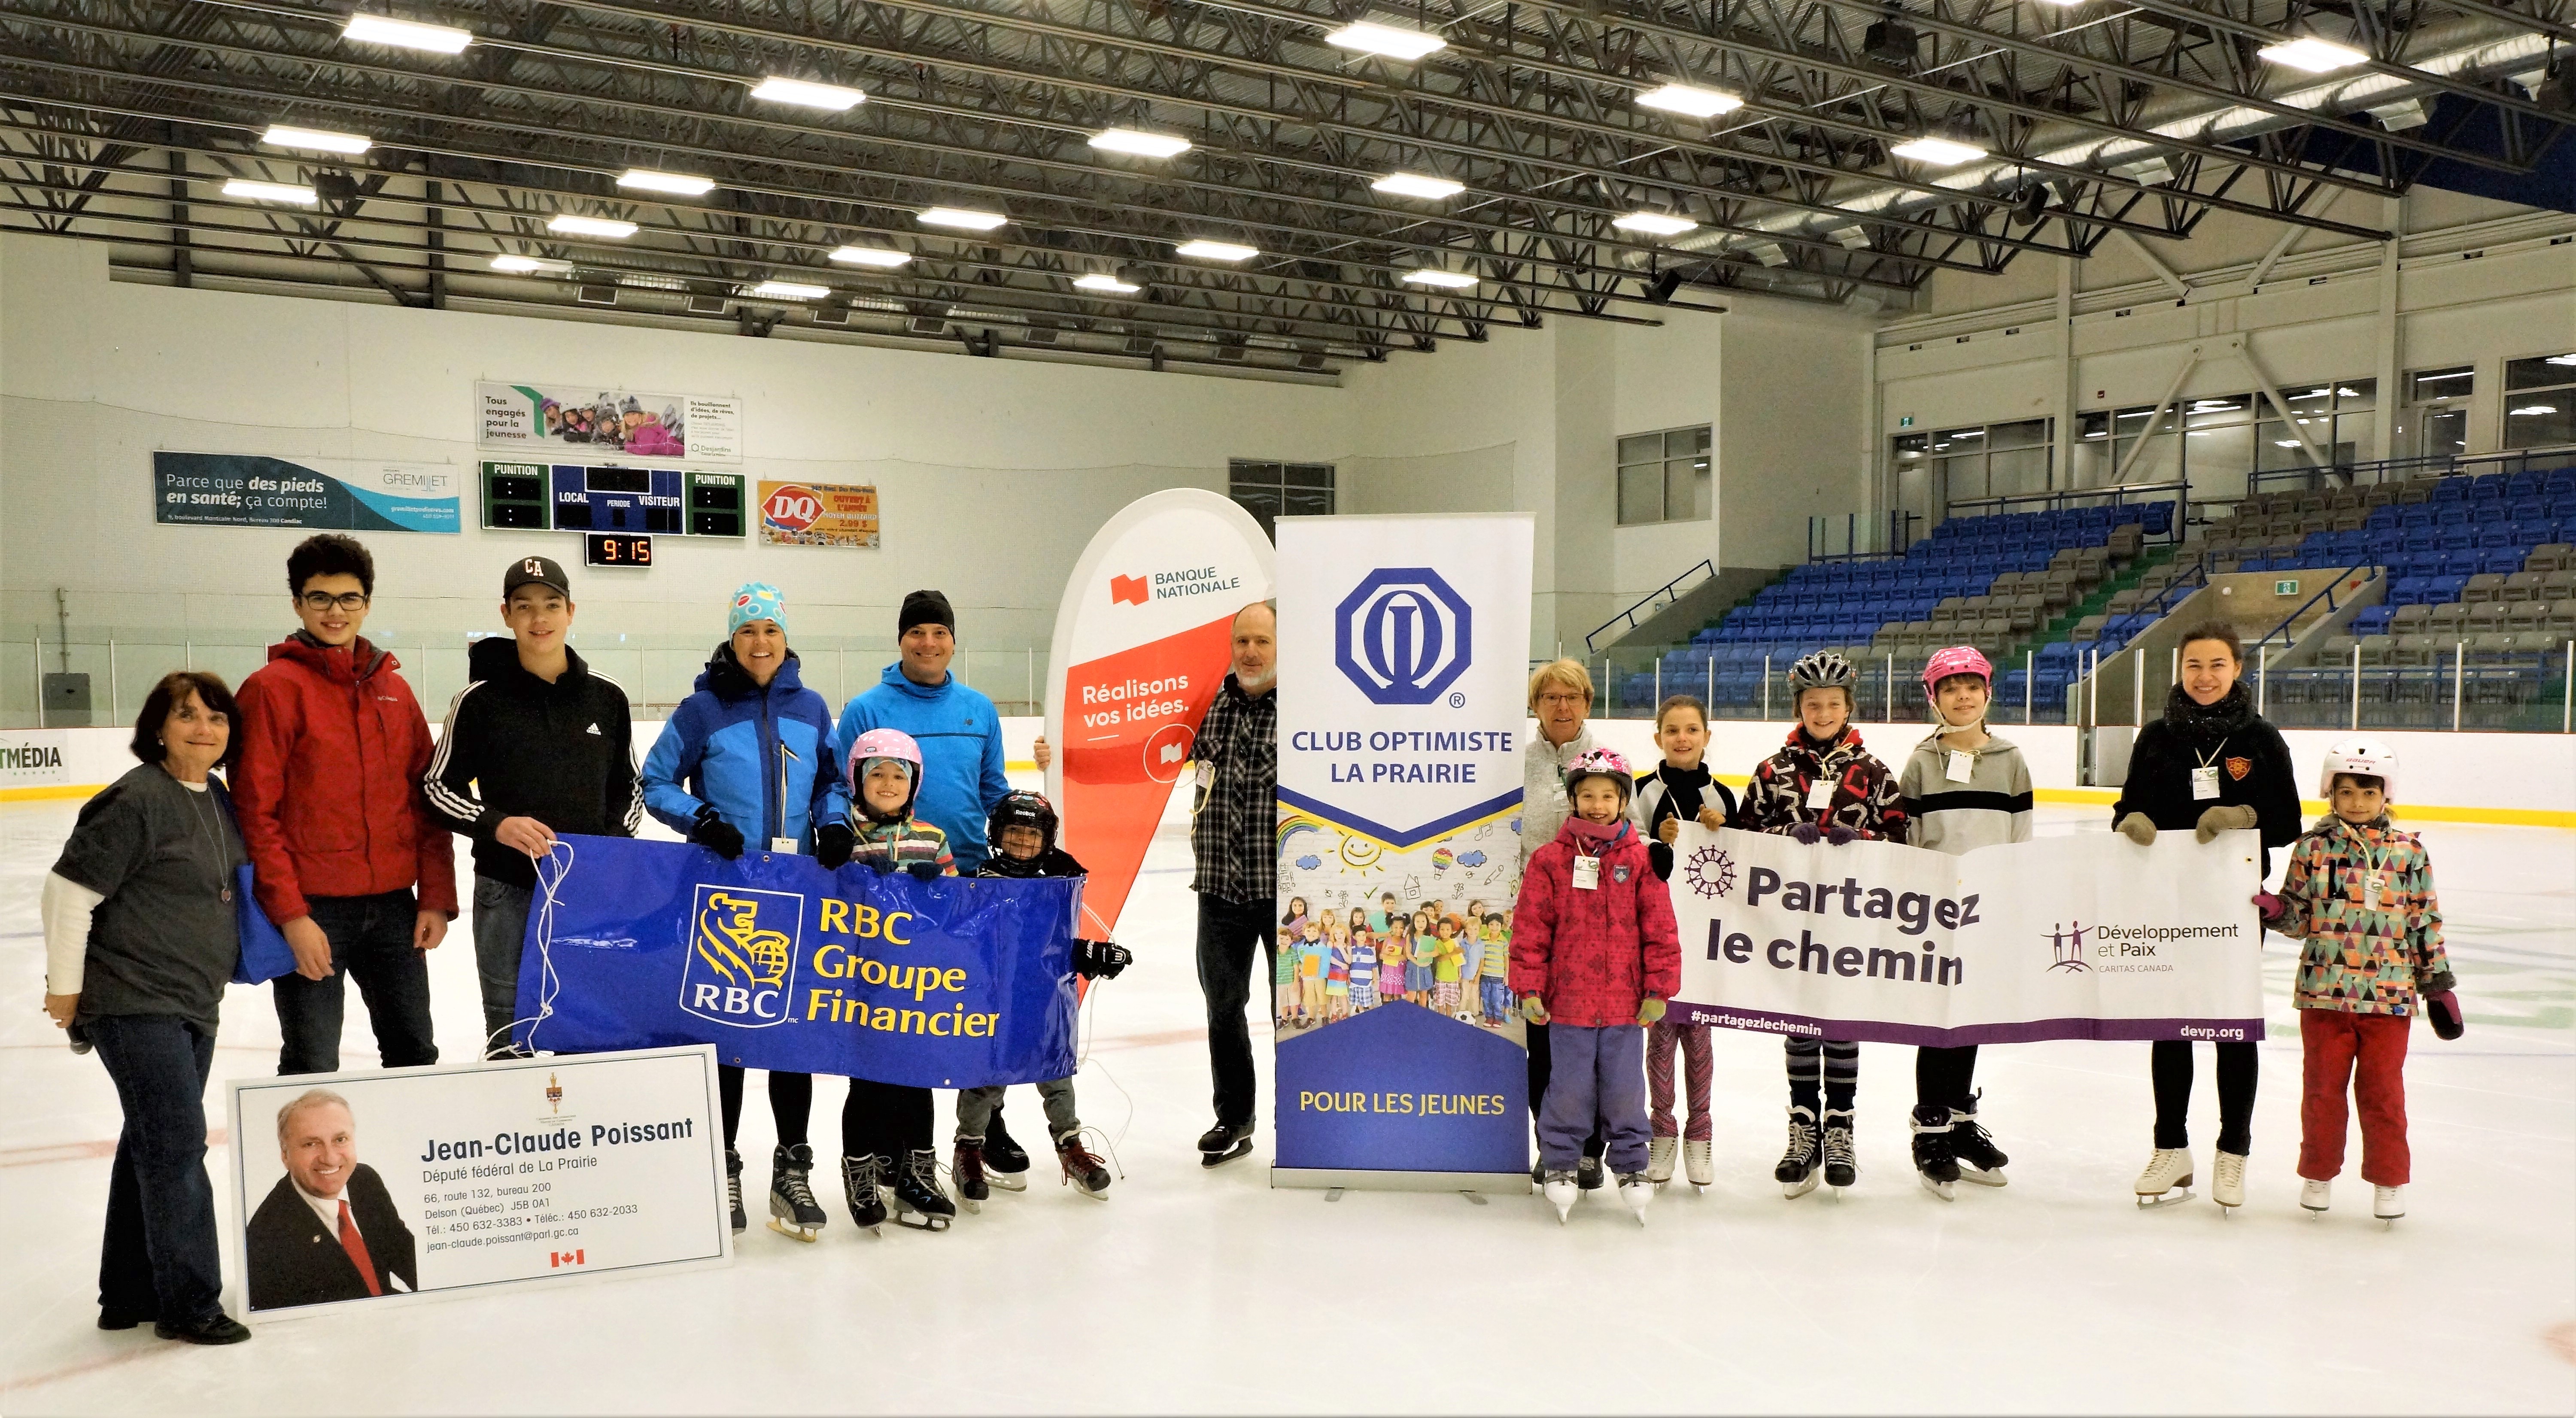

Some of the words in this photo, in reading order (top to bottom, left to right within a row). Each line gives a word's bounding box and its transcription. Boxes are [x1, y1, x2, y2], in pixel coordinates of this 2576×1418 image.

[486, 396, 507, 405] Tous
[486, 409, 526, 418] engagés
[486, 429, 527, 438] jeunesse
[494, 464, 538, 476] PUNITION
[696, 474, 735, 486] PUNITION
[167, 474, 209, 488] Parce
[215, 479, 243, 491] que
[249, 477, 277, 491] des
[280, 477, 324, 494] pieds
[167, 492, 186, 504] en
[190, 491, 241, 508] santé;
[246, 496, 262, 510] ça
[267, 497, 327, 510] compte!
[559, 492, 589, 503] LOCAL
[638, 495, 680, 507] VISITEUR
[773, 495, 815, 523] DQ
[604, 540, 650, 562] 9:15
[524, 559, 544, 577] CA
[1155, 566, 1217, 584] BANQUE
[1157, 577, 1240, 599] NATIONALE
[1082, 675, 1188, 704] Réalisons
[1084, 710, 1121, 728] vos
[1127, 699, 1190, 722] idées.
[1292, 731, 1362, 751] CLUB
[1370, 731, 1512, 752] OPTIMISTE
[1331, 763, 1364, 783] LA
[1373, 763, 1476, 783] PRAIRIE
[1747, 866, 1980, 935] Partagez
[820, 898, 912, 945] RBC
[2098, 923, 2239, 942] Développement
[1707, 918, 1753, 964] le
[1767, 929, 1963, 986] chemin
[2098, 943, 2114, 957] et
[2120, 942, 2156, 956] Paix
[814, 945, 966, 1002] Groupe
[2099, 965, 2135, 973] CARITAS
[2138, 964, 2173, 972] CANADA
[694, 983, 779, 1018] RBC
[807, 989, 1000, 1037] Financier
[1691, 1010, 1822, 1036] #partagezlechemin
[2181, 1025, 2244, 1040] devp.org
[1300, 1091, 1367, 1112] POUR
[1373, 1093, 1413, 1114] LES
[1418, 1094, 1505, 1115] JEUNES
[422, 1128, 581, 1162] Jean-Claude
[592, 1118, 693, 1147] Poissant
[423, 1167, 467, 1184] Député
[472, 1163, 514, 1178] fédéral
[519, 1161, 534, 1174] de
[539, 1158, 553, 1172] La
[559, 1156, 597, 1170] Prairie
[424, 1194, 440, 1204] 66,
[444, 1191, 467, 1202] route
[471, 1188, 493, 1199] 132,
[497, 1184, 529, 1196] bureau
[532, 1182, 551, 1193] 200
[425, 1208, 457, 1219] Delson
[461, 1203, 504, 1217] (Québec)
[511, 1200, 529, 1211] J5B
[426, 1224, 446, 1236] Tél.:
[450, 1221, 469, 1232] 450
[473, 1216, 522, 1230] 632-3383
[535, 1212, 565, 1224] Téléc.:
[568, 1209, 586, 1220] 450
[590, 1204, 638, 1218] 632-2033
[427, 1227, 579, 1253] jean-claude.poissant@parl.gc.ca
